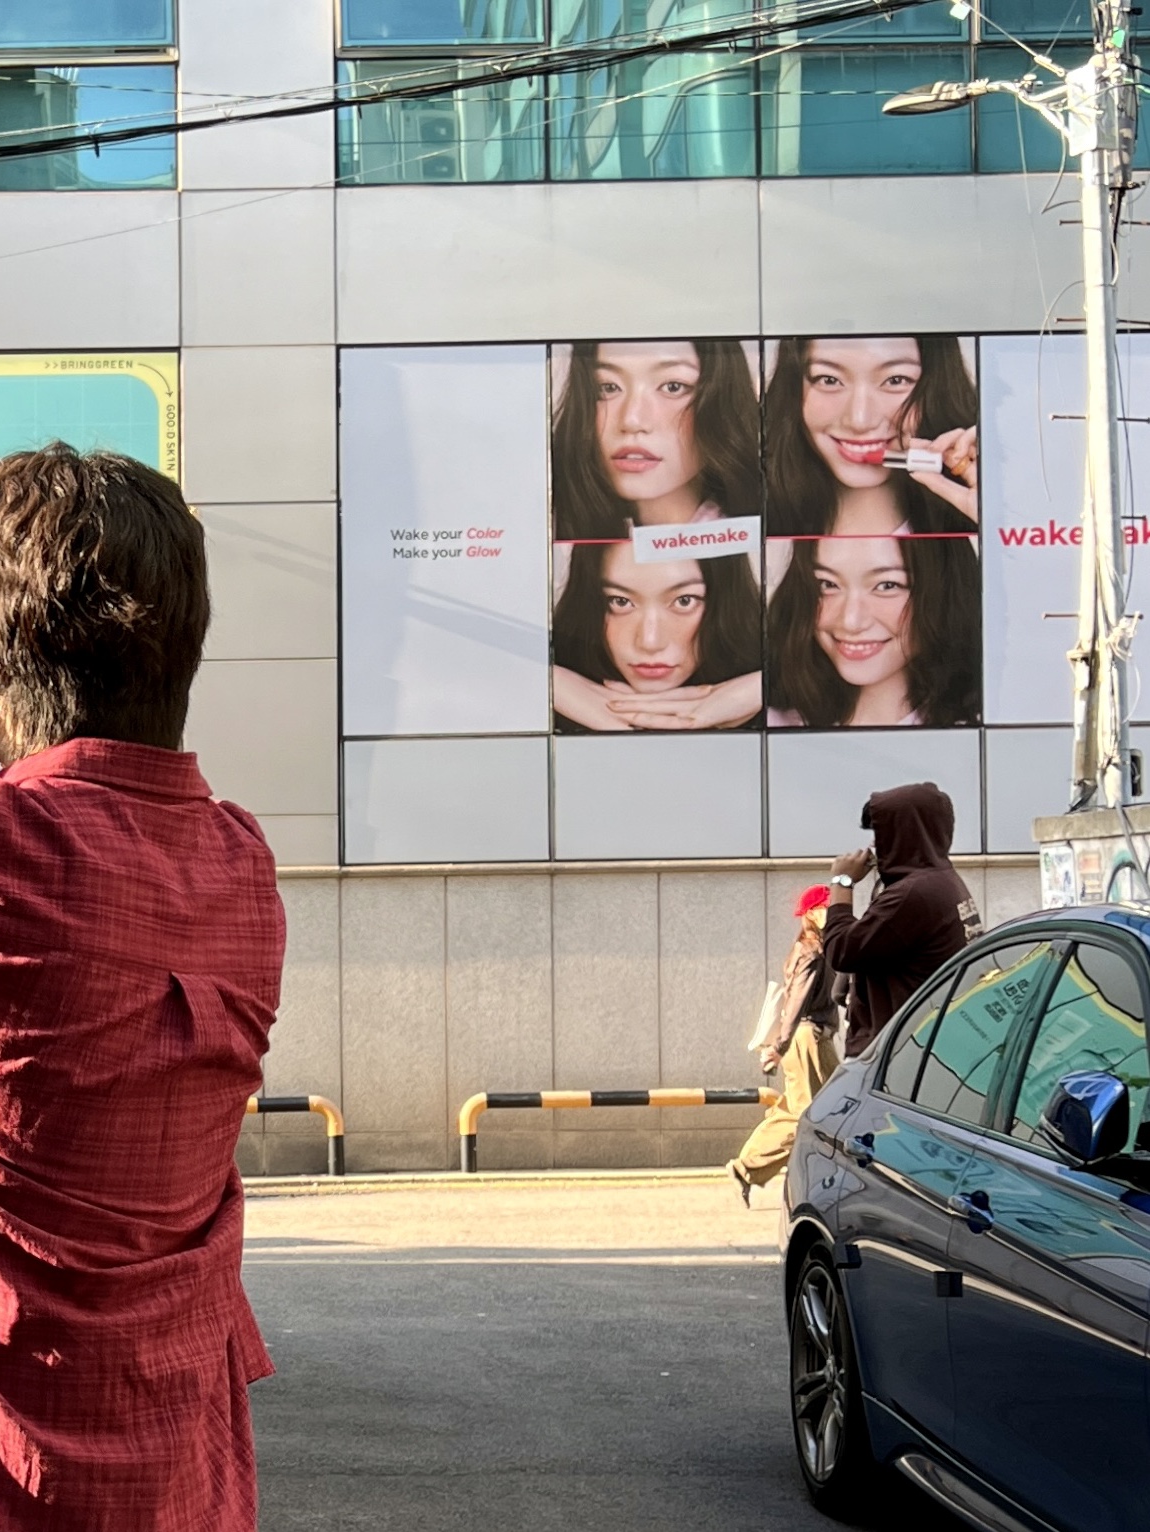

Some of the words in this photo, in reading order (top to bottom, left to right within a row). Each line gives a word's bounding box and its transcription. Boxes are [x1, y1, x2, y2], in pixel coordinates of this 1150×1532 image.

[390, 528, 429, 541] Wake
[432, 529, 463, 542] your
[466, 527, 504, 539] Color
[652, 528, 748, 550] wakemake
[393, 546, 429, 559] Make
[432, 547, 463, 561] your
[466, 546, 502, 558] Glow
